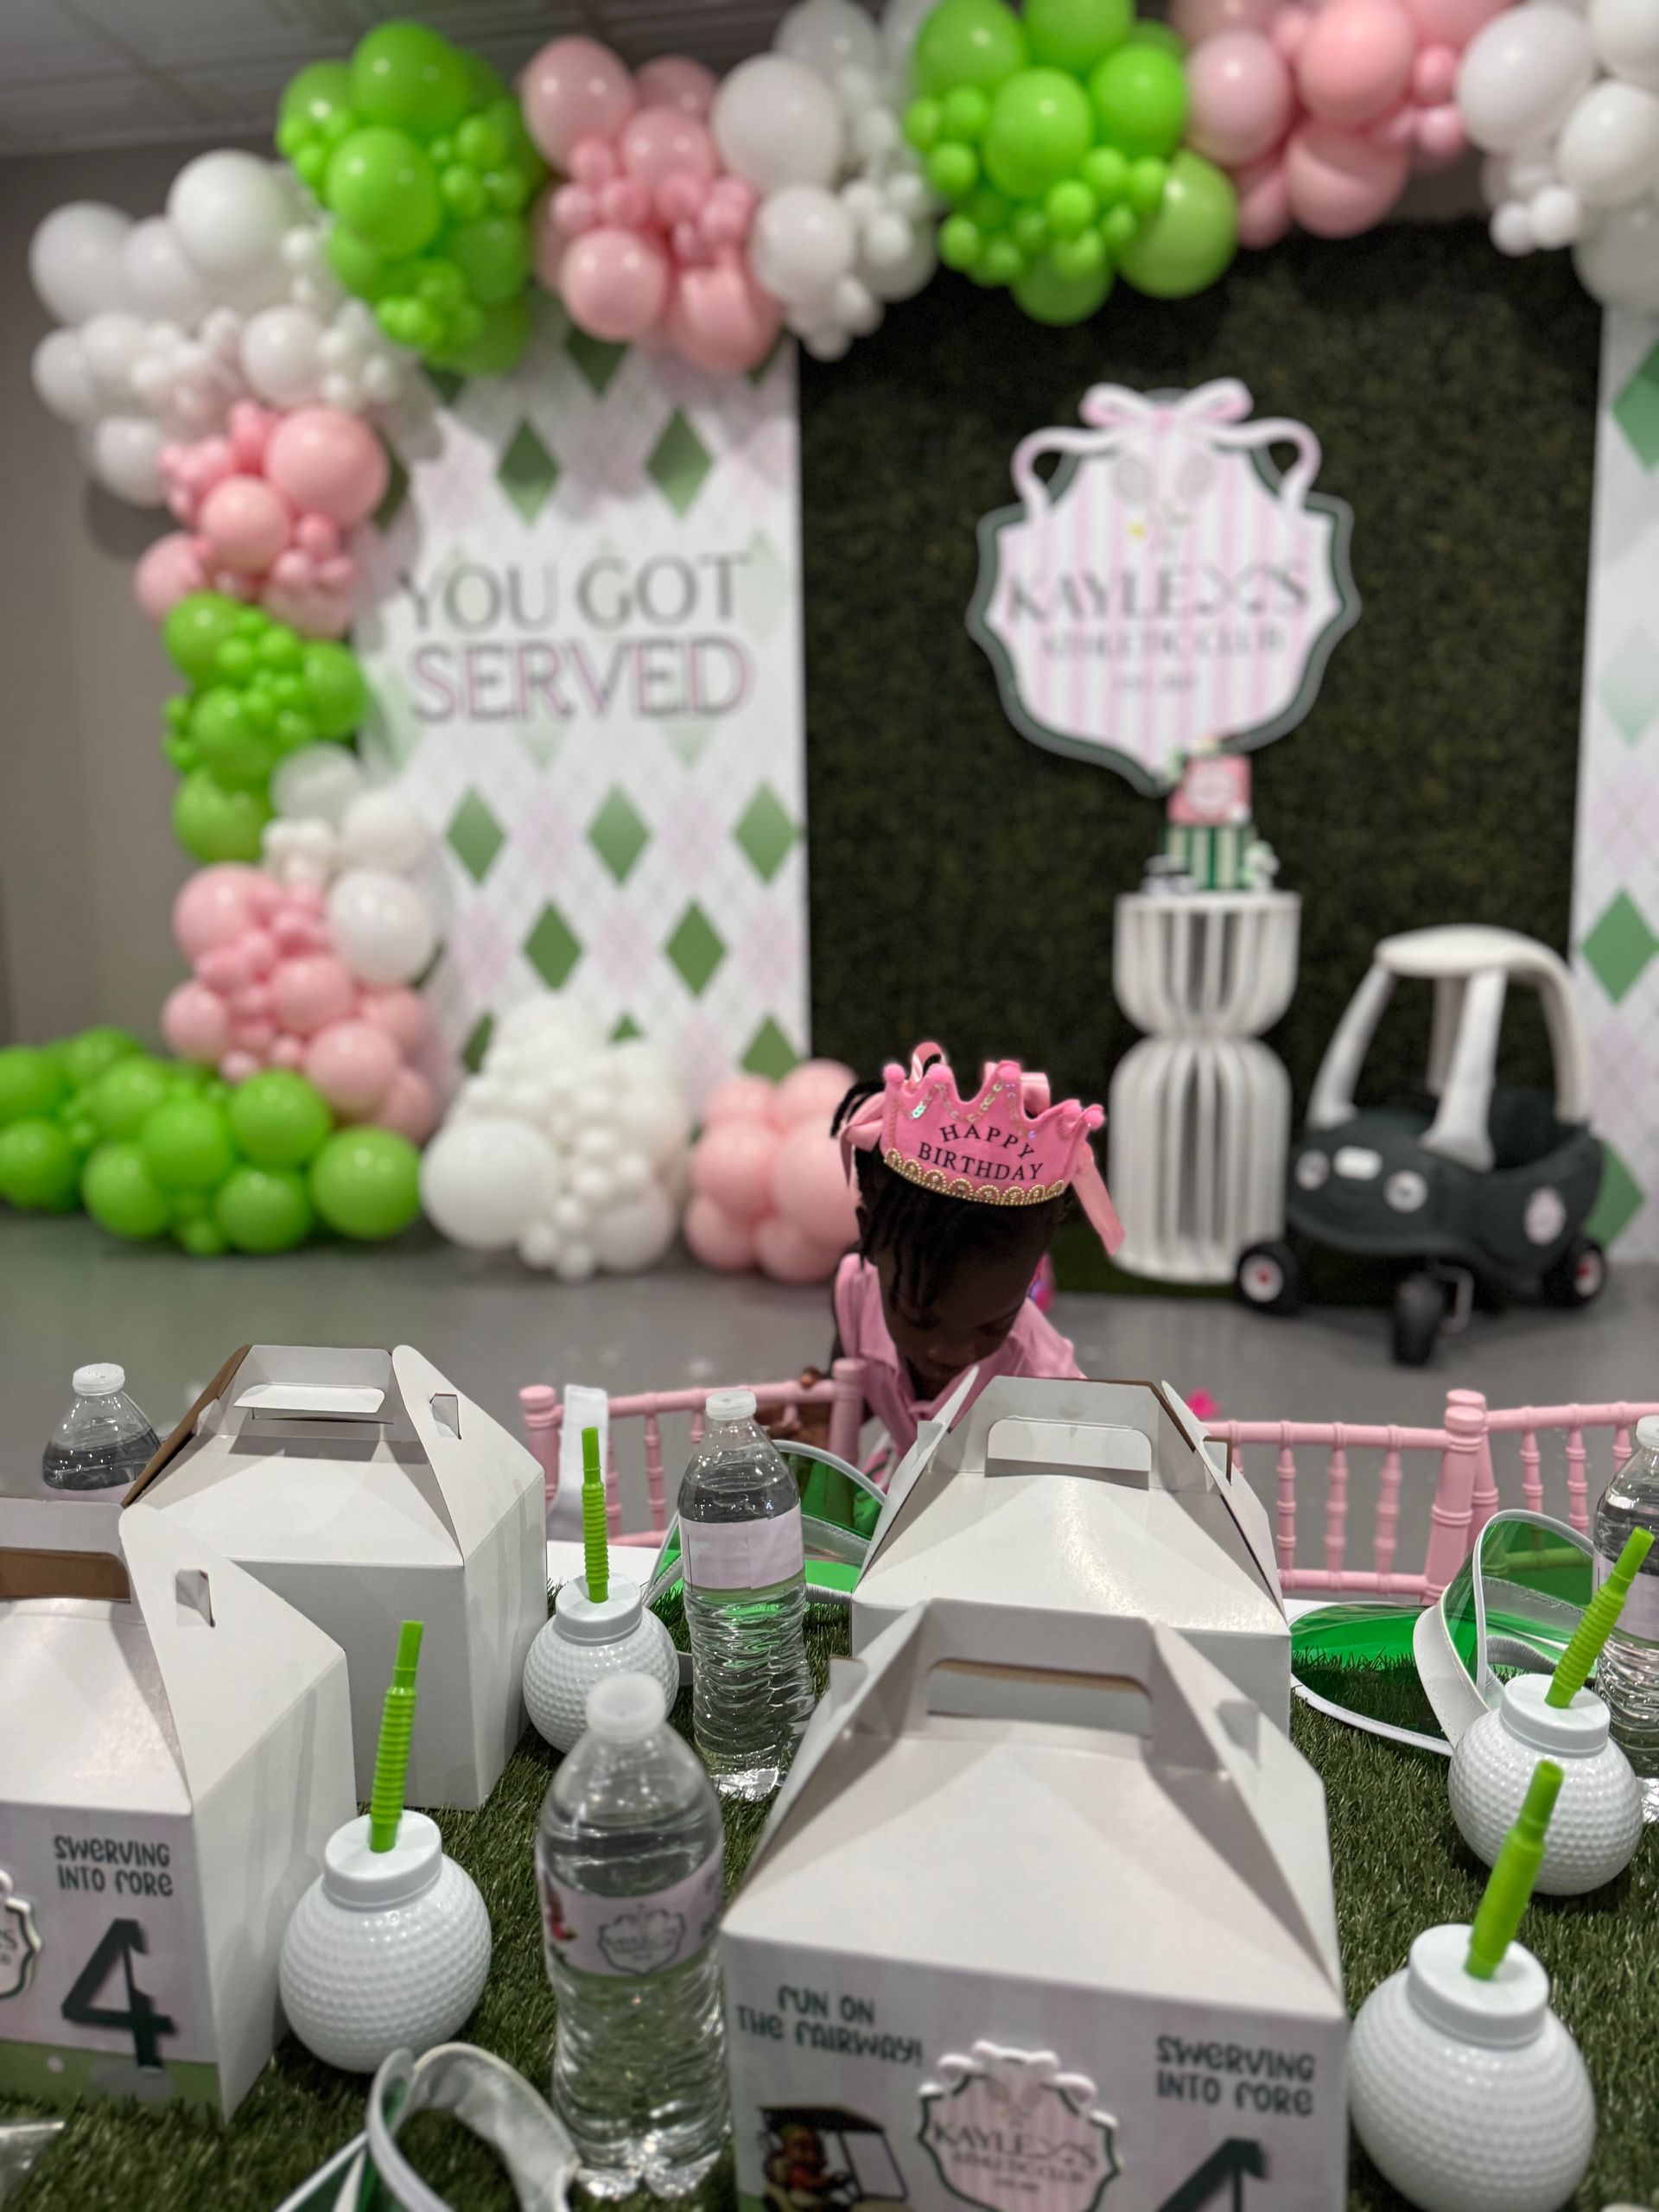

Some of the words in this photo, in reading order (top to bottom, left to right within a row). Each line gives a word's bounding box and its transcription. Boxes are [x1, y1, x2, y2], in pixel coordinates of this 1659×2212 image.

[396, 562, 558, 634] YOU
[575, 551, 753, 632] GOT
[410, 634, 756, 723] SERVED
[917, 1141, 1044, 1181] BIRTHDAY
[939, 1123, 1034, 1160] HAPPY
[58, 1866, 105, 1892] INTO
[60, 1918, 177, 2068] 4
[778, 1985, 829, 2019] FUN
[840, 1993, 875, 2026] ON
[795, 2019, 924, 2067] FAIRWAY!
[1156, 2070, 1222, 2105] INTO
